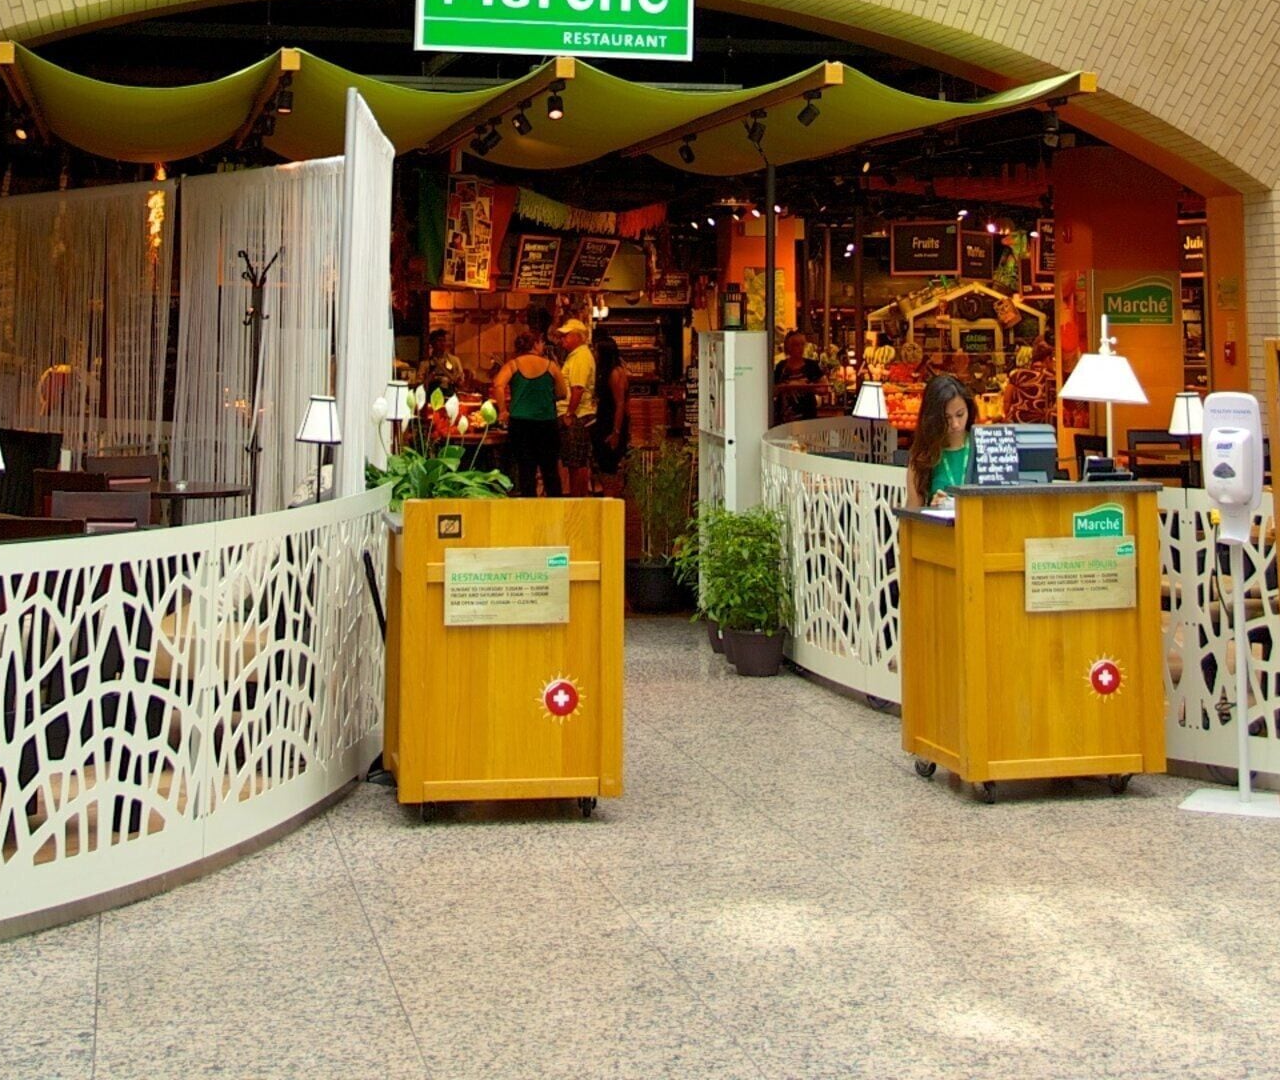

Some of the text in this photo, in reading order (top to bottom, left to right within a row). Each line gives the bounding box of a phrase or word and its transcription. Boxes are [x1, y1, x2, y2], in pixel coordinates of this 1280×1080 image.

[563, 31, 668, 49] RESTAURANT
[912, 237, 940, 250] Fruits
[1107, 296, 1168, 313] Marché
[1077, 517, 1120, 530] Marché
[451, 572, 549, 582] RESTAURANT HOURS
